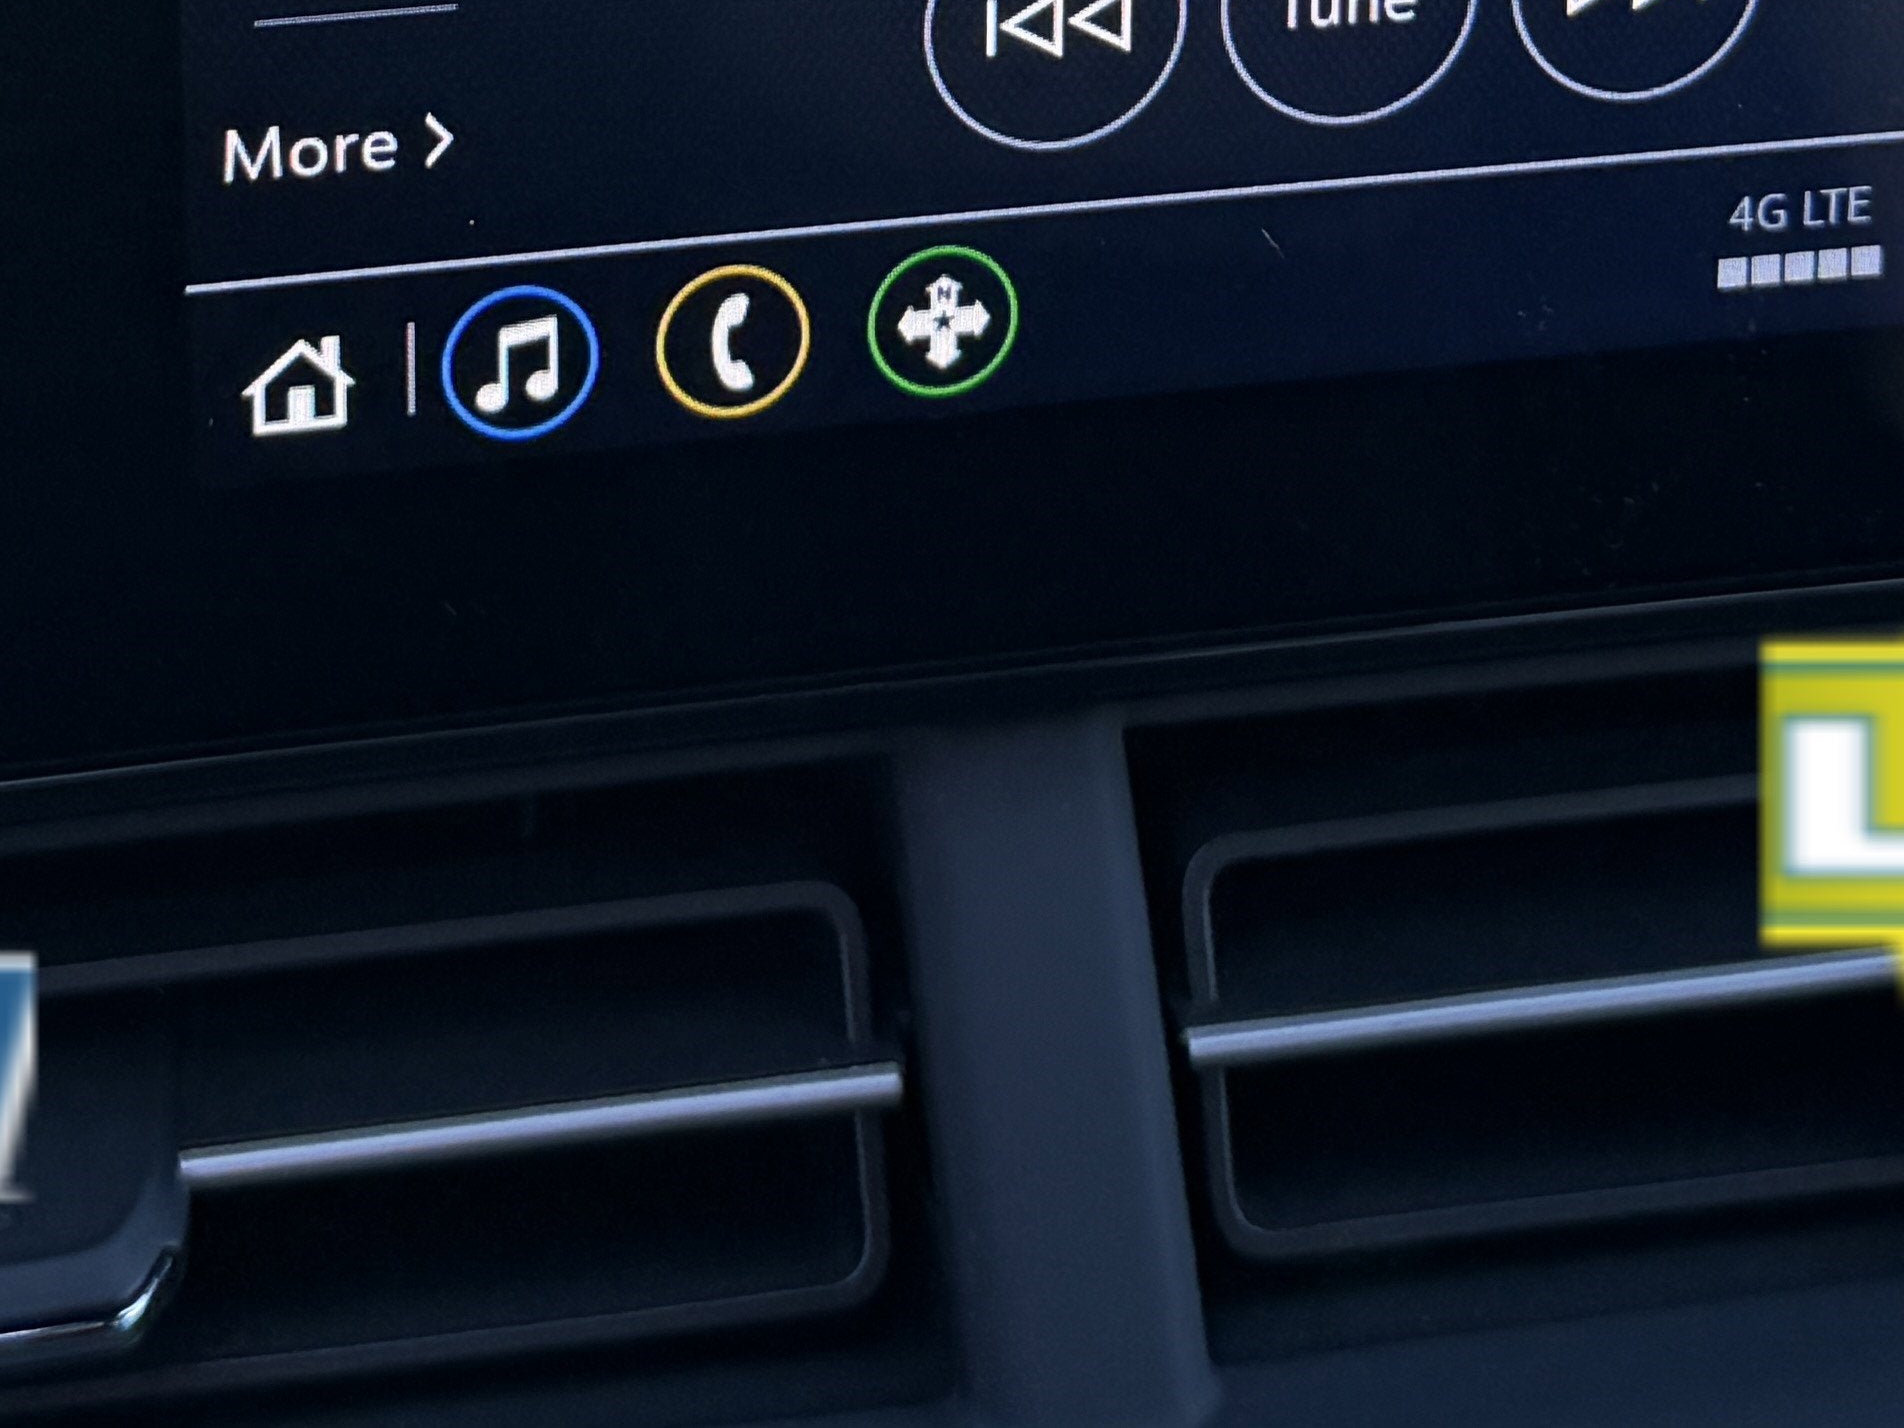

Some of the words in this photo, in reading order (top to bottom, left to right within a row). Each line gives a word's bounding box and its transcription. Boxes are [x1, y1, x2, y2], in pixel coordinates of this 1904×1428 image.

[221, 123, 400, 186] More
[1726, 192, 1789, 235] 4G
[1799, 184, 1875, 228] LTE
